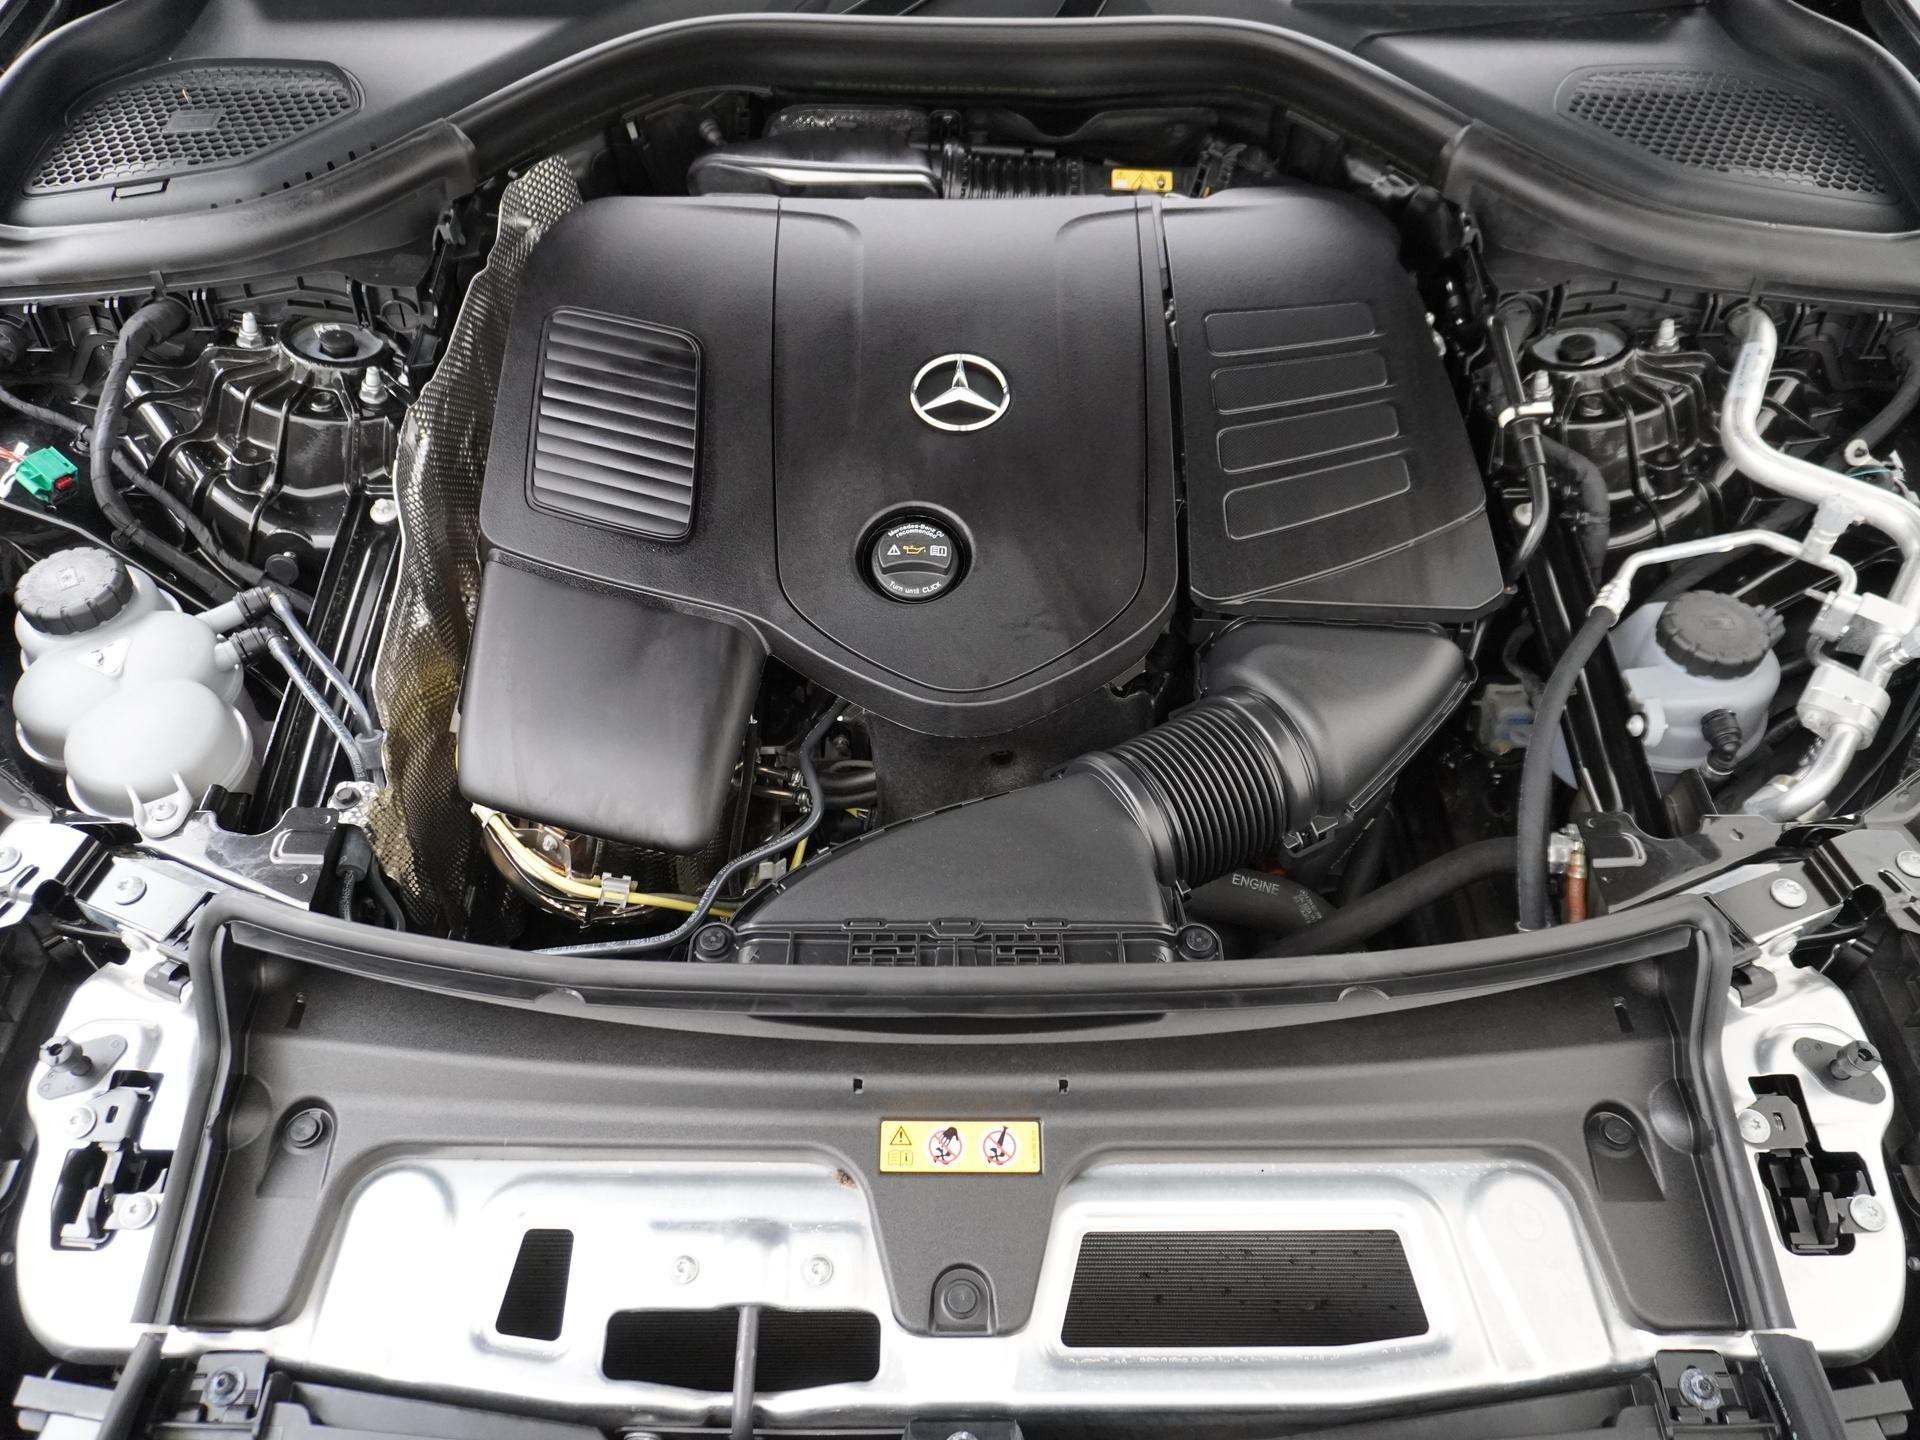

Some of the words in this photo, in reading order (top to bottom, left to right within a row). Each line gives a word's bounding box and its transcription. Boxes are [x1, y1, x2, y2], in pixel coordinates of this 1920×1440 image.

[888, 524, 936, 537] Mercedes-Benz
[895, 528, 938, 539] recommended
[889, 580, 903, 592] Turn
[922, 581, 942, 594] CLICK
[1231, 873, 1281, 896] ENGINE
